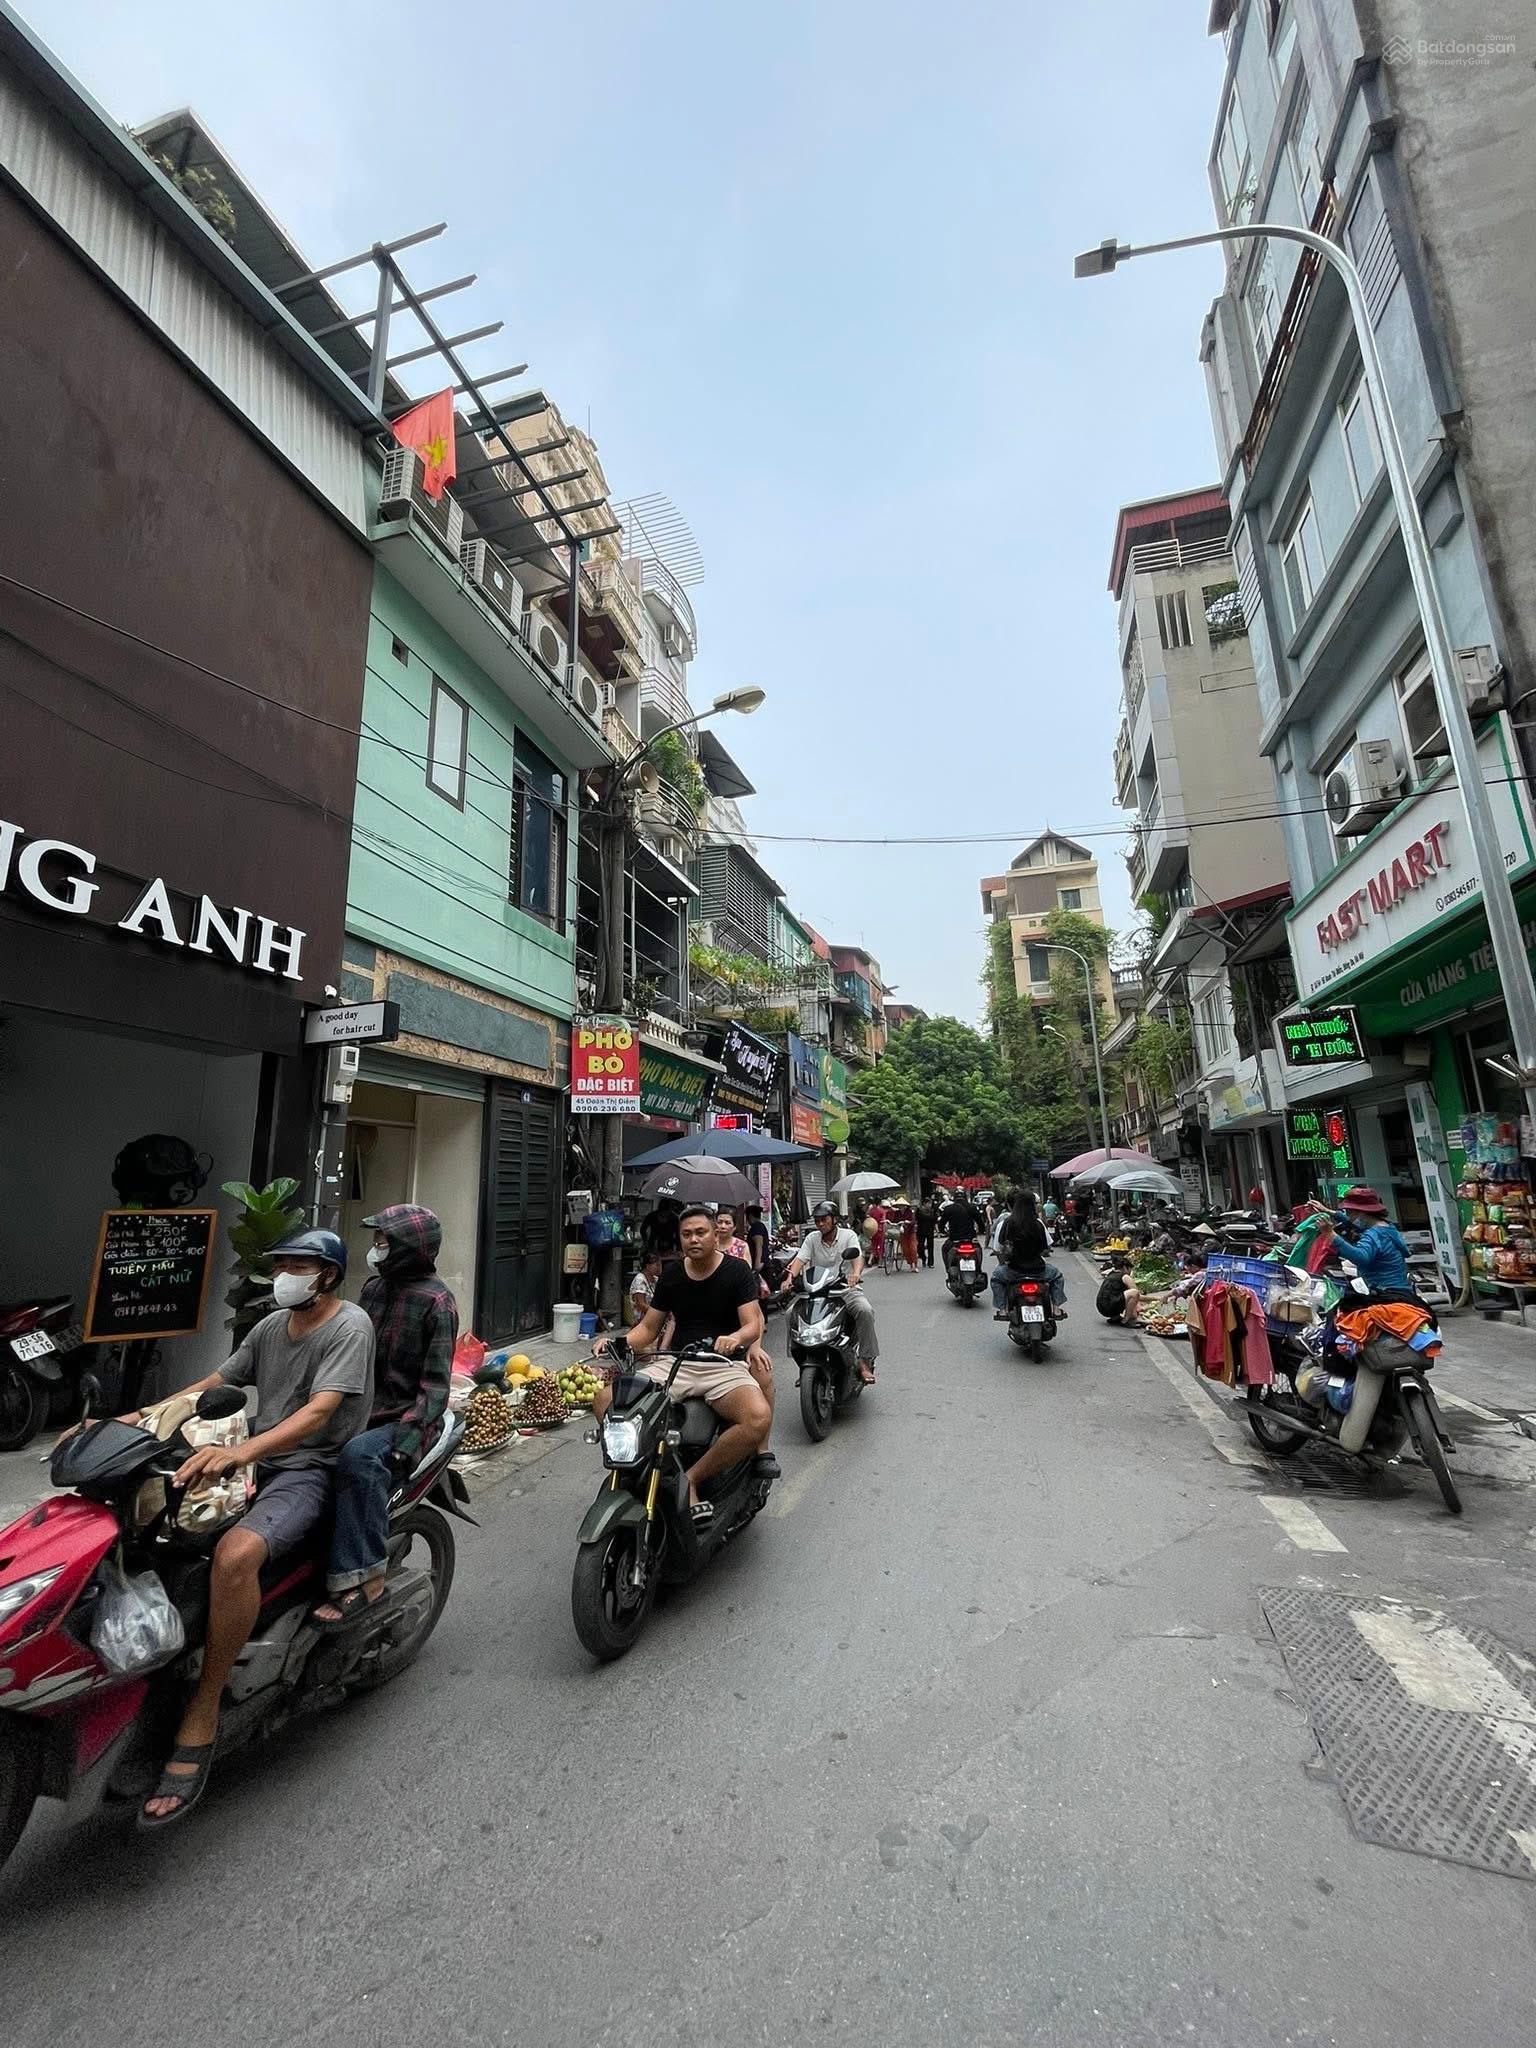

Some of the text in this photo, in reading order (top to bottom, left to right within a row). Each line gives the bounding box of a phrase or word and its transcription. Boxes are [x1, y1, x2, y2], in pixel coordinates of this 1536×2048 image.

[1316, 820, 1452, 954] FAST MART
[118, 877, 307, 982] ANH
[1400, 940, 1496, 1007] CỬA HÀNG TIỆ
[318, 1011, 359, 1023] A good day
[1286, 1015, 1349, 1039] NHÀ THUỐC
[333, 1023, 376, 1035] for hair cut
[579, 1028, 633, 1050] PHỞ
[588, 1052, 624, 1074] BÒ
[577, 1077, 634, 1094] ĐẶC BIỆT
